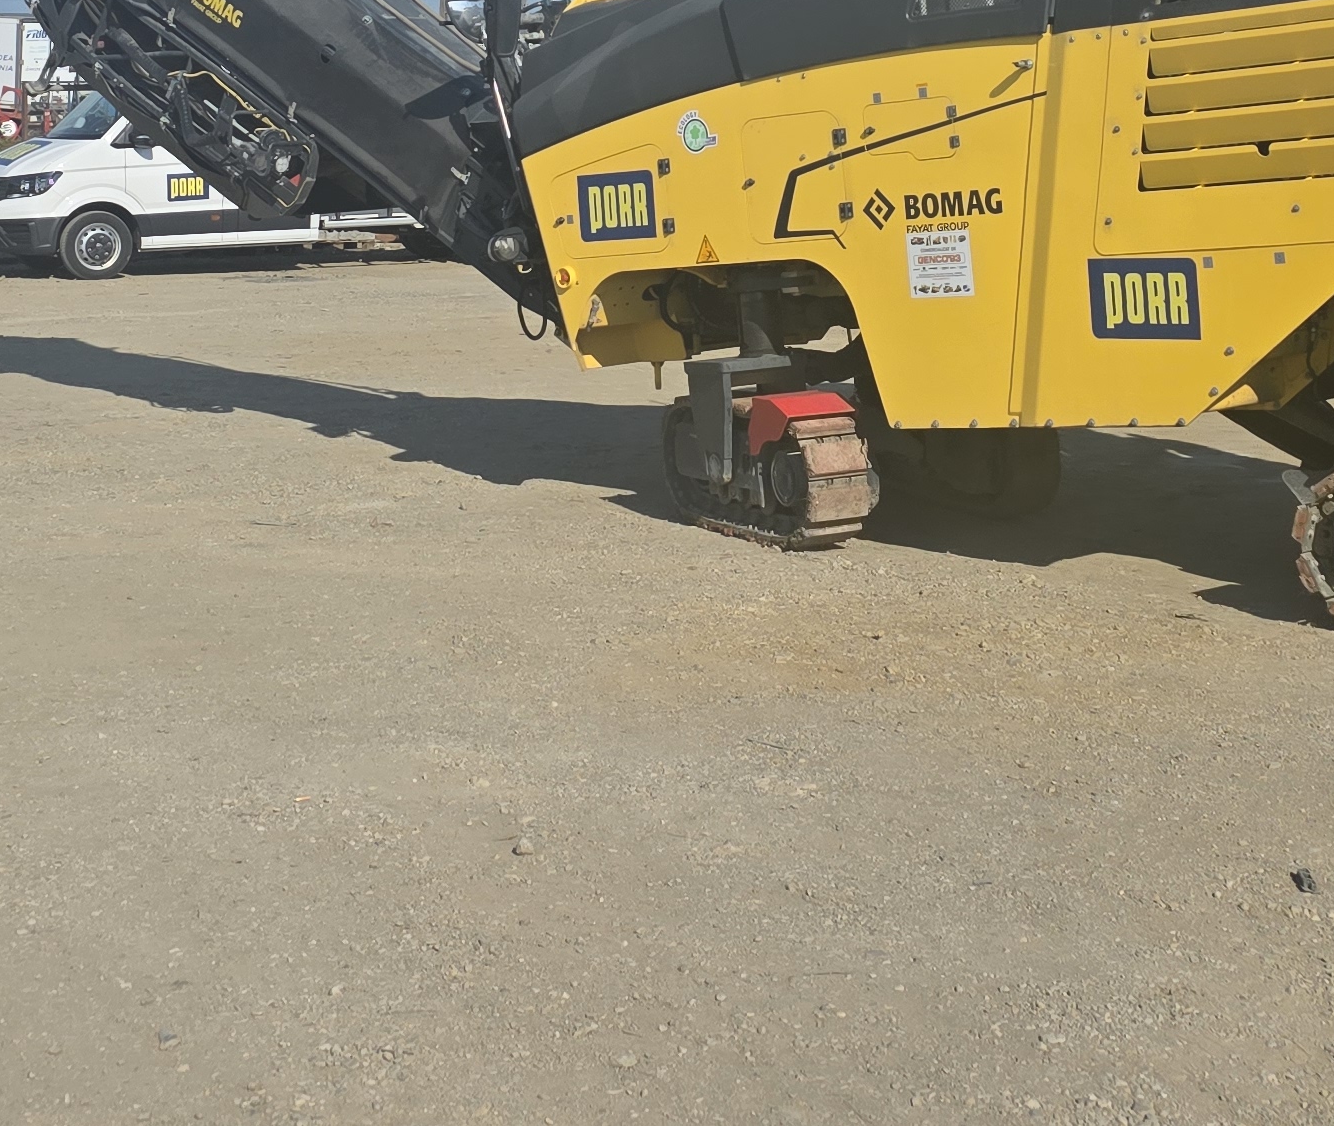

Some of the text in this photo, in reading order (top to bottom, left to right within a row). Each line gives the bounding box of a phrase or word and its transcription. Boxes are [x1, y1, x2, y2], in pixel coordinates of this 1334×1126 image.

[678, 111, 697, 134] ECOLOGY
[170, 176, 204, 199] PORR
[588, 183, 649, 233] PORR
[904, 187, 1003, 220] BOMAG
[906, 222, 969, 234] FAYAT GROUP
[1103, 273, 1189, 328] PORR
